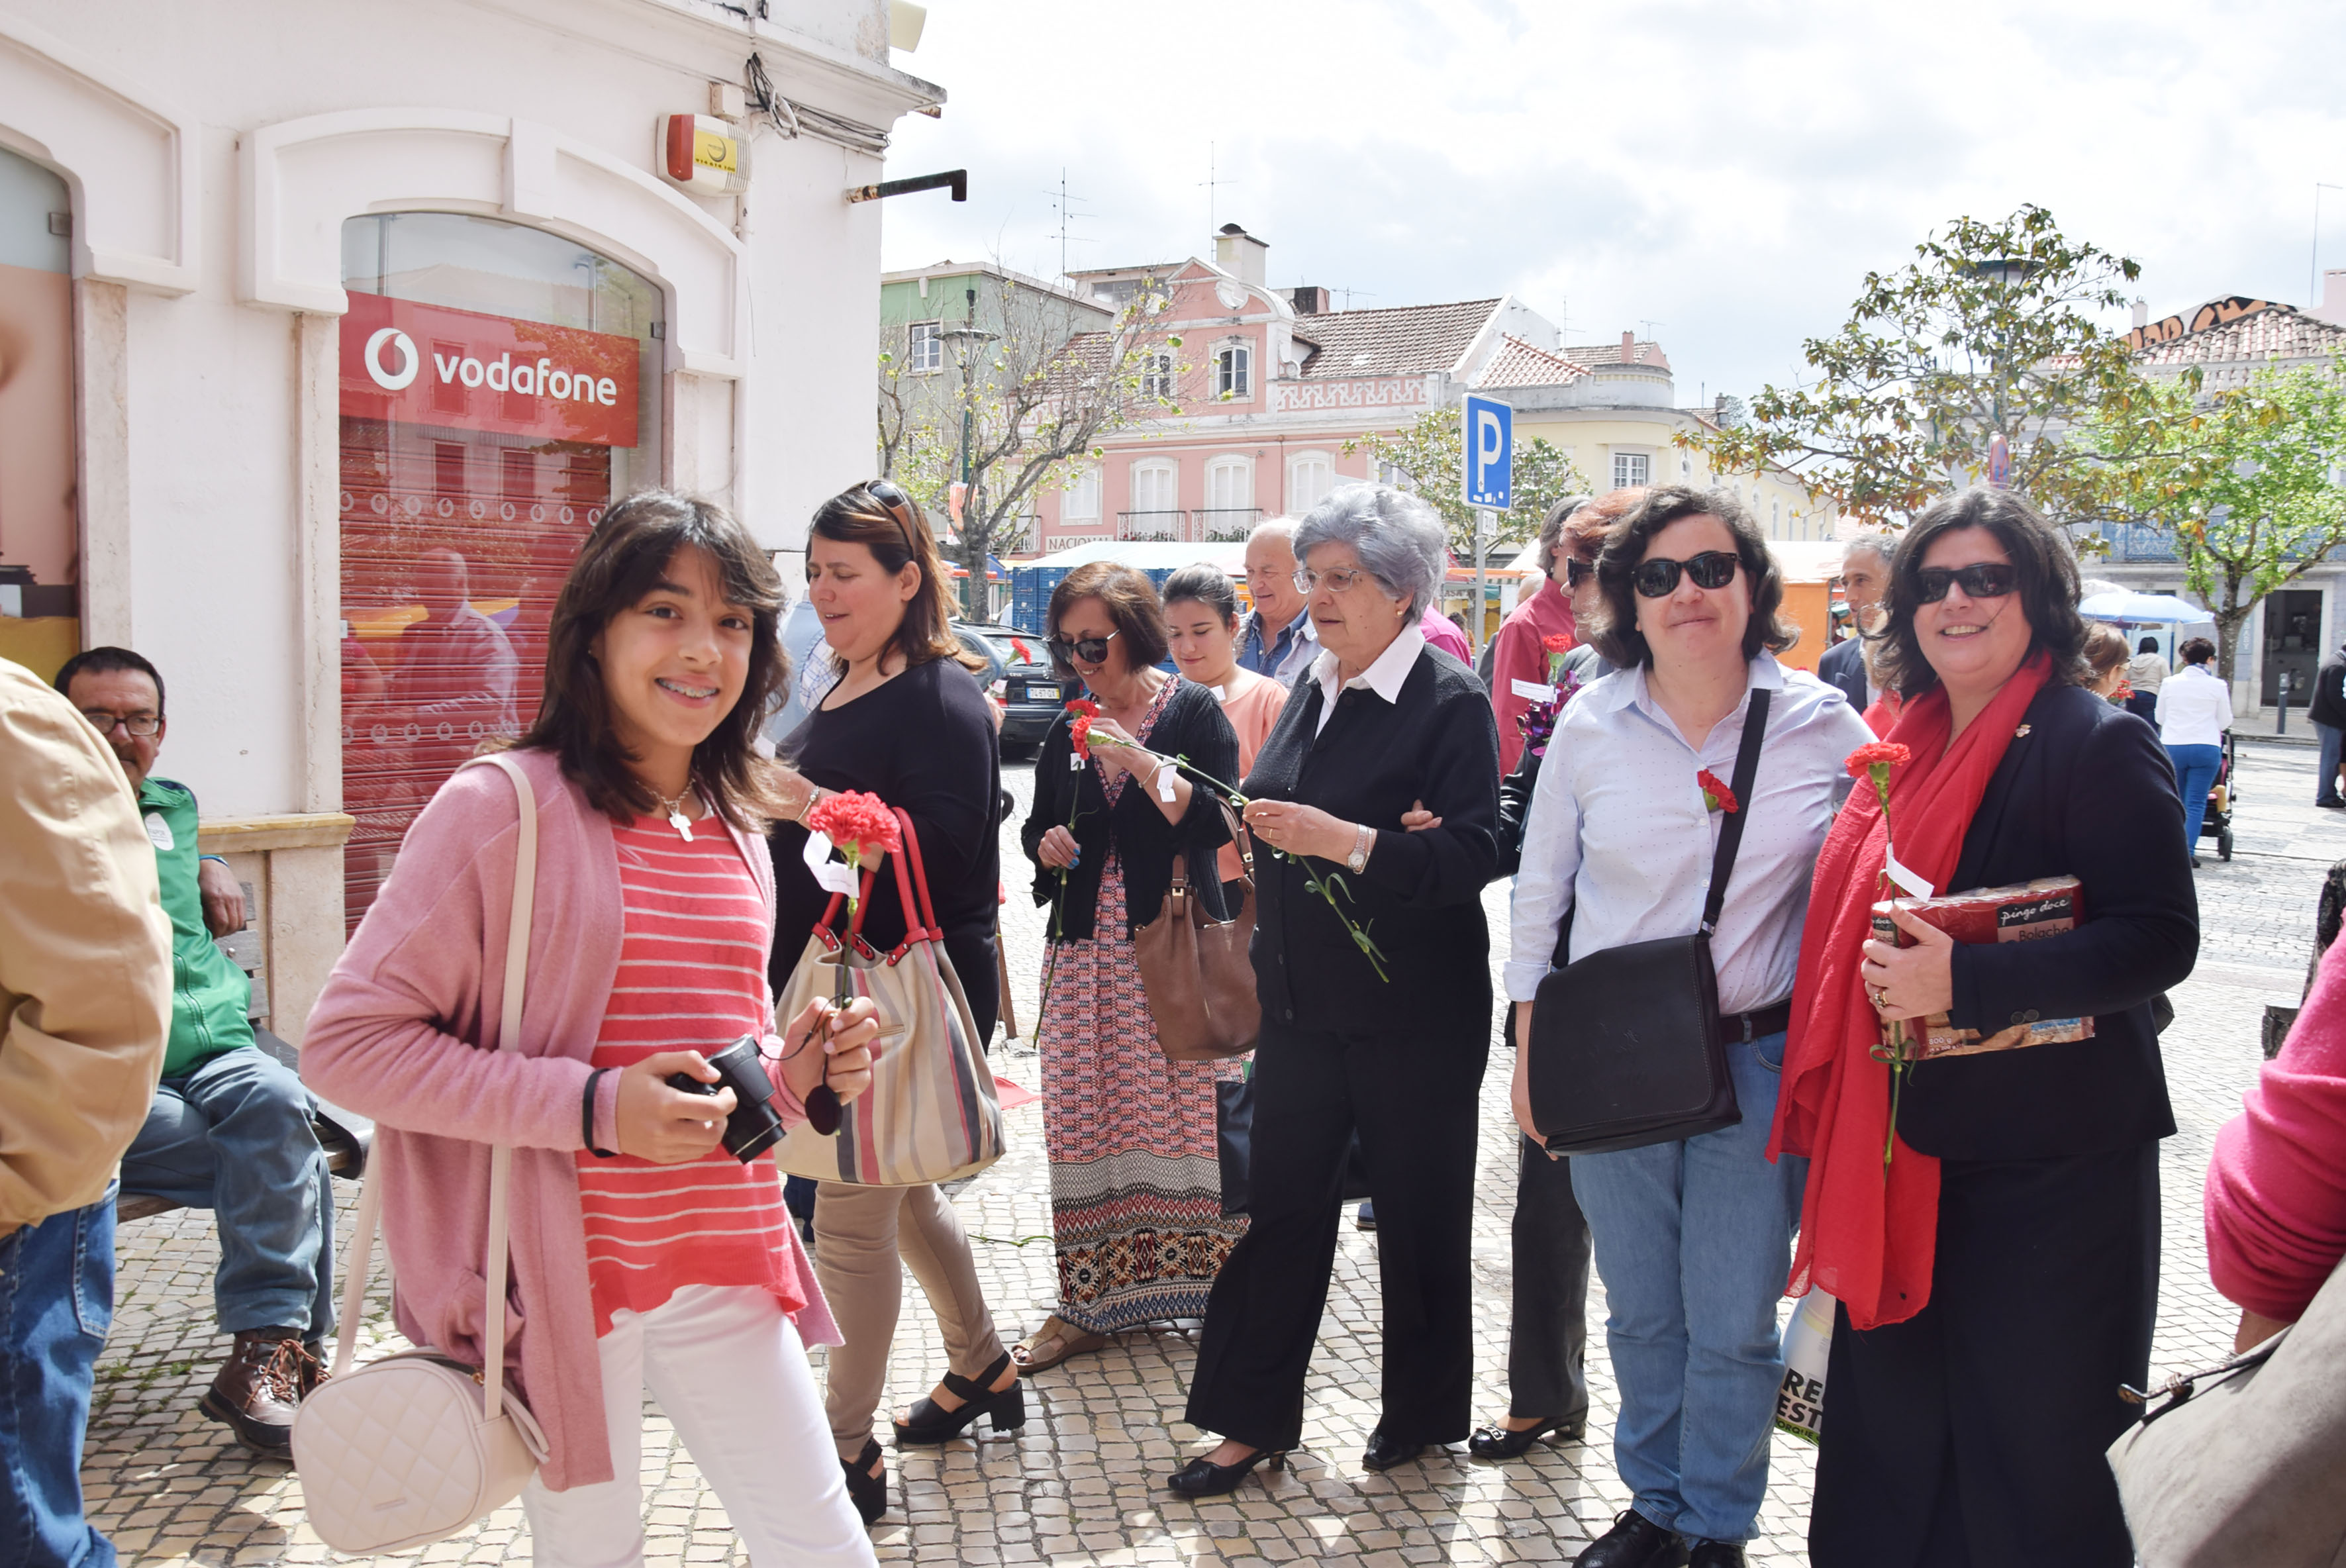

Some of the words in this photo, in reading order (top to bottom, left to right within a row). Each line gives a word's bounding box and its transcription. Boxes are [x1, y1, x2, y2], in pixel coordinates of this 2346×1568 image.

[434, 353, 616, 405] vodafone
[1478, 409, 1502, 493] P
[2000, 907, 2037, 926] pingo
[2039, 899, 2070, 912] doce
[1783, 1368, 1823, 1404] RE
[1776, 1419, 1813, 1439] ORQUE
